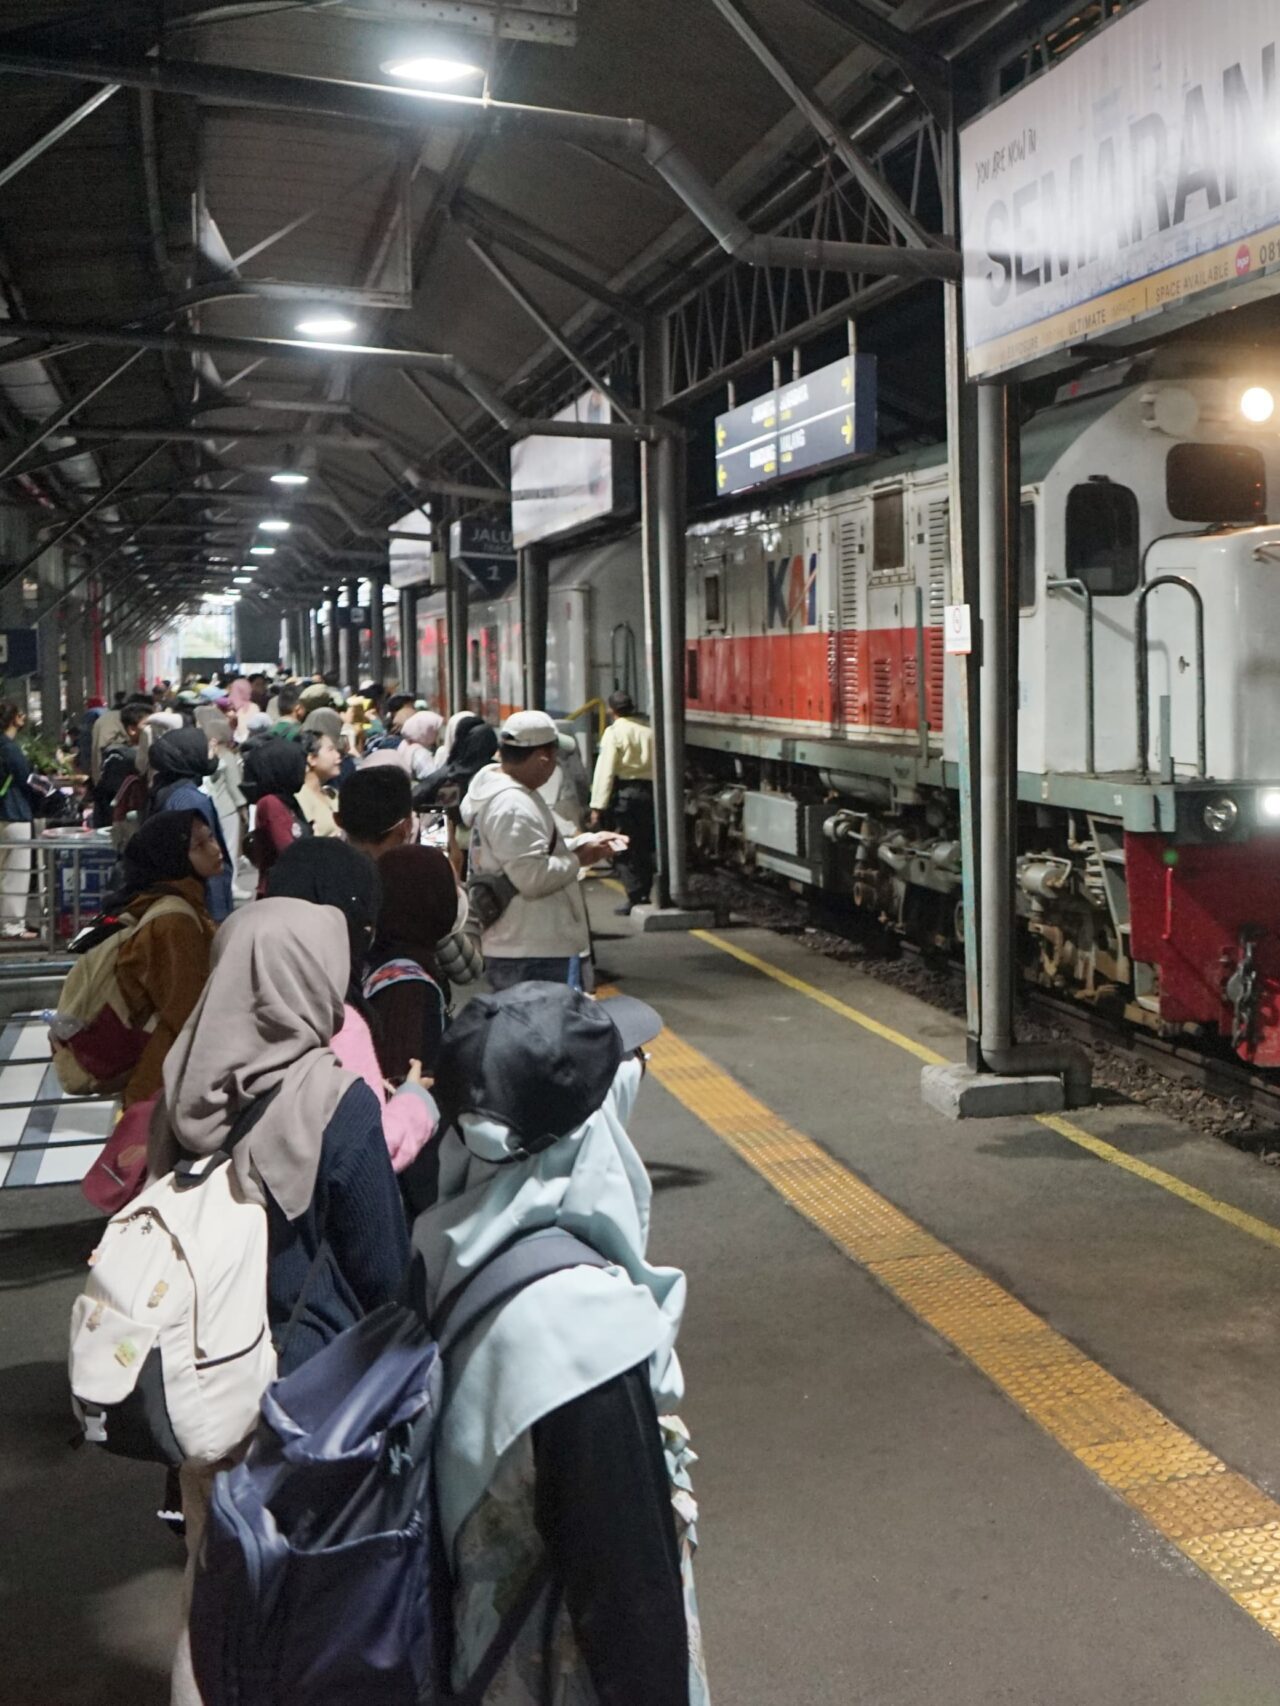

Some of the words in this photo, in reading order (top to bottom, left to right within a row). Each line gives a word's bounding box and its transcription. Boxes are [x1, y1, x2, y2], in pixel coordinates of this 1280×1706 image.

[975, 159, 990, 192] YOU
[992, 146, 1006, 179] ARE
[1008, 128, 1026, 168] NOW
[1028, 128, 1037, 154] IN
[1155, 280, 1181, 302] SPACE
[1183, 262, 1229, 290] AVAILABLE
[487, 565, 501, 580] 1
[767, 553, 817, 629] KAI
